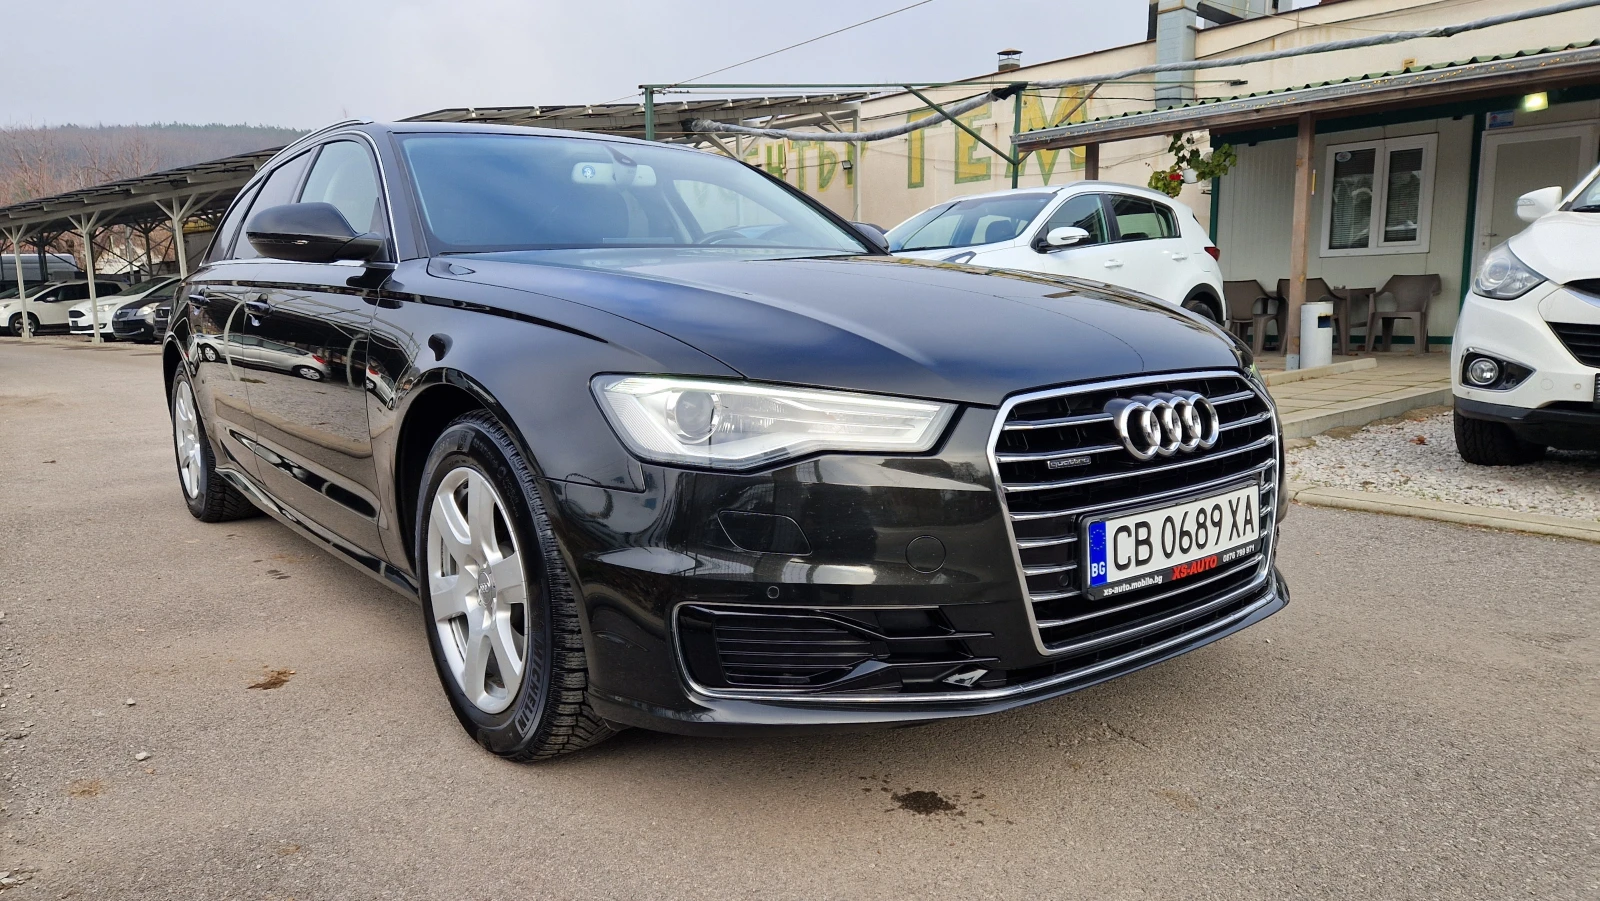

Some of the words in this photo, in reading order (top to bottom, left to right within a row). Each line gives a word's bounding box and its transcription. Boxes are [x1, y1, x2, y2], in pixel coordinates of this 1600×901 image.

[1050, 457, 1090, 468] quattro
[1113, 520, 1154, 572] CB
[1161, 503, 1223, 559] 0689
[1228, 494, 1255, 542] XA
[1091, 561, 1106, 577] BG
[1103, 575, 1163, 596] xs-auto.mobile.bg
[1171, 554, 1218, 580] XS-AUTO
[517, 636, 544, 733] MICHELIN
